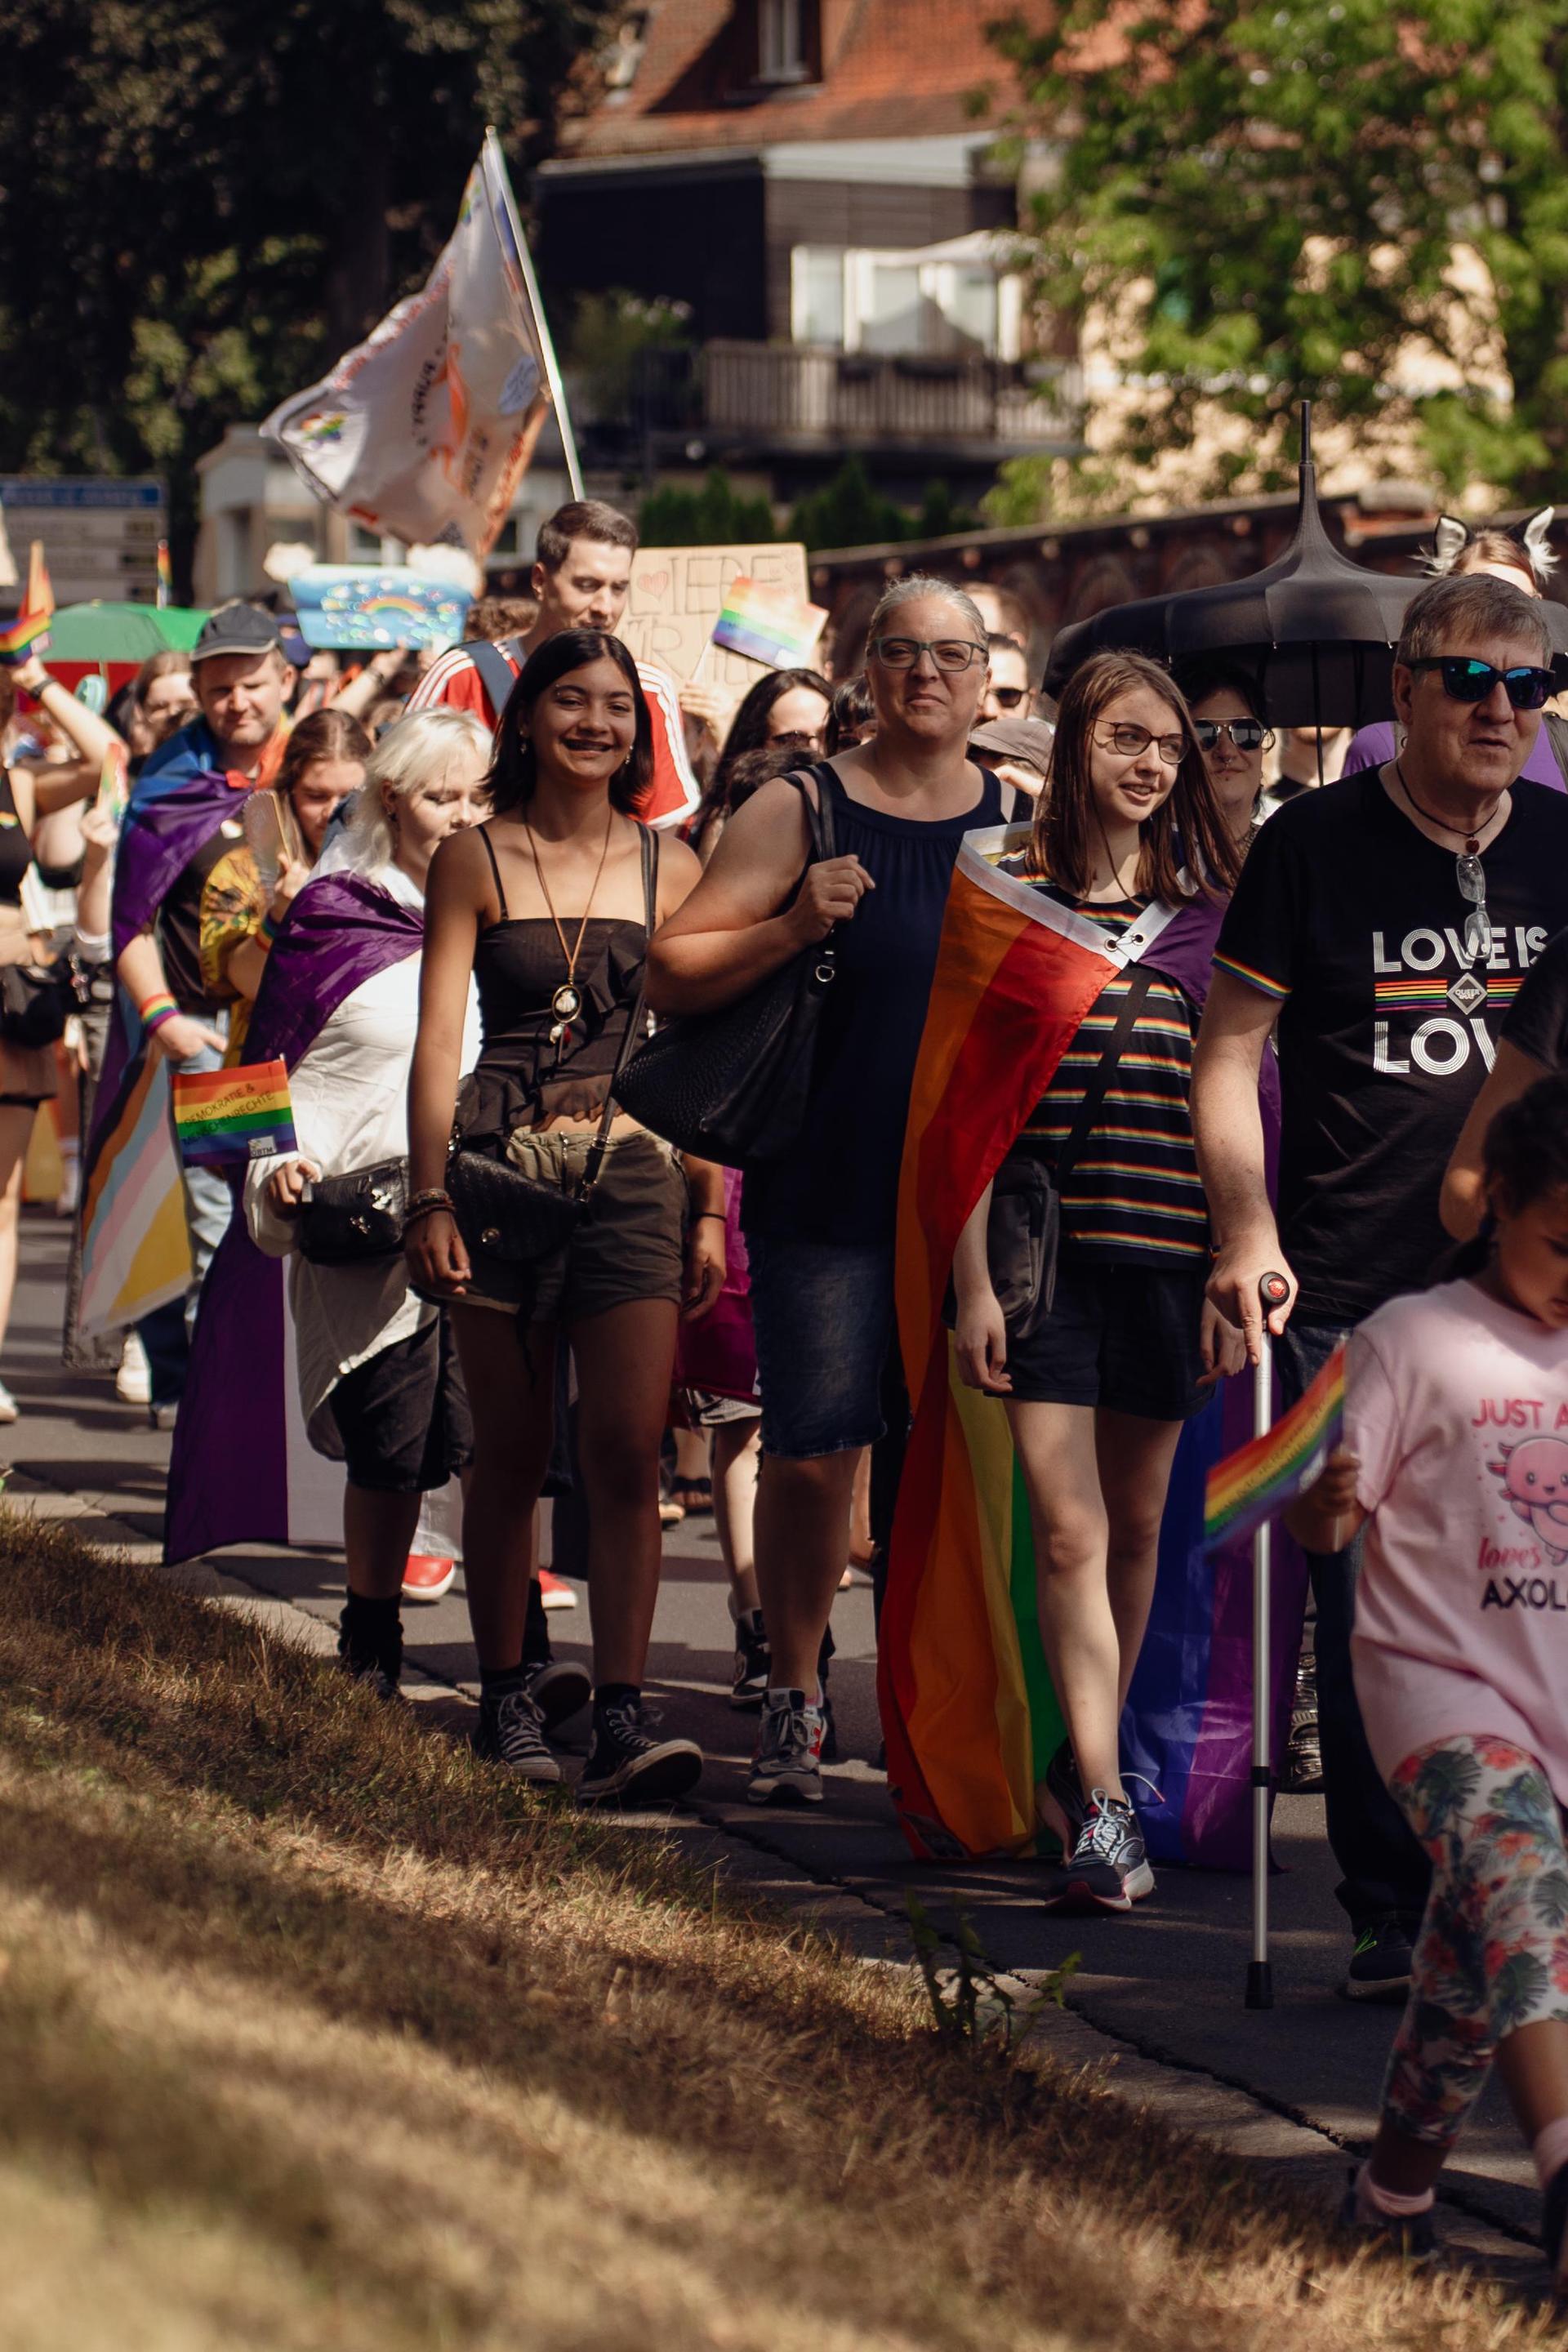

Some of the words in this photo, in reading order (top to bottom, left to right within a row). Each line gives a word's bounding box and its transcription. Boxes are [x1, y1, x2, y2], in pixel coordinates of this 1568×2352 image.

[1373, 928, 1510, 973] LOVE
[1515, 927, 1548, 968] IS
[1374, 1018, 1497, 1076] LOV
[1471, 1398, 1544, 1429] JUST
[1477, 1537, 1543, 1570] loves
[1481, 1577, 1568, 1610] AXOL
